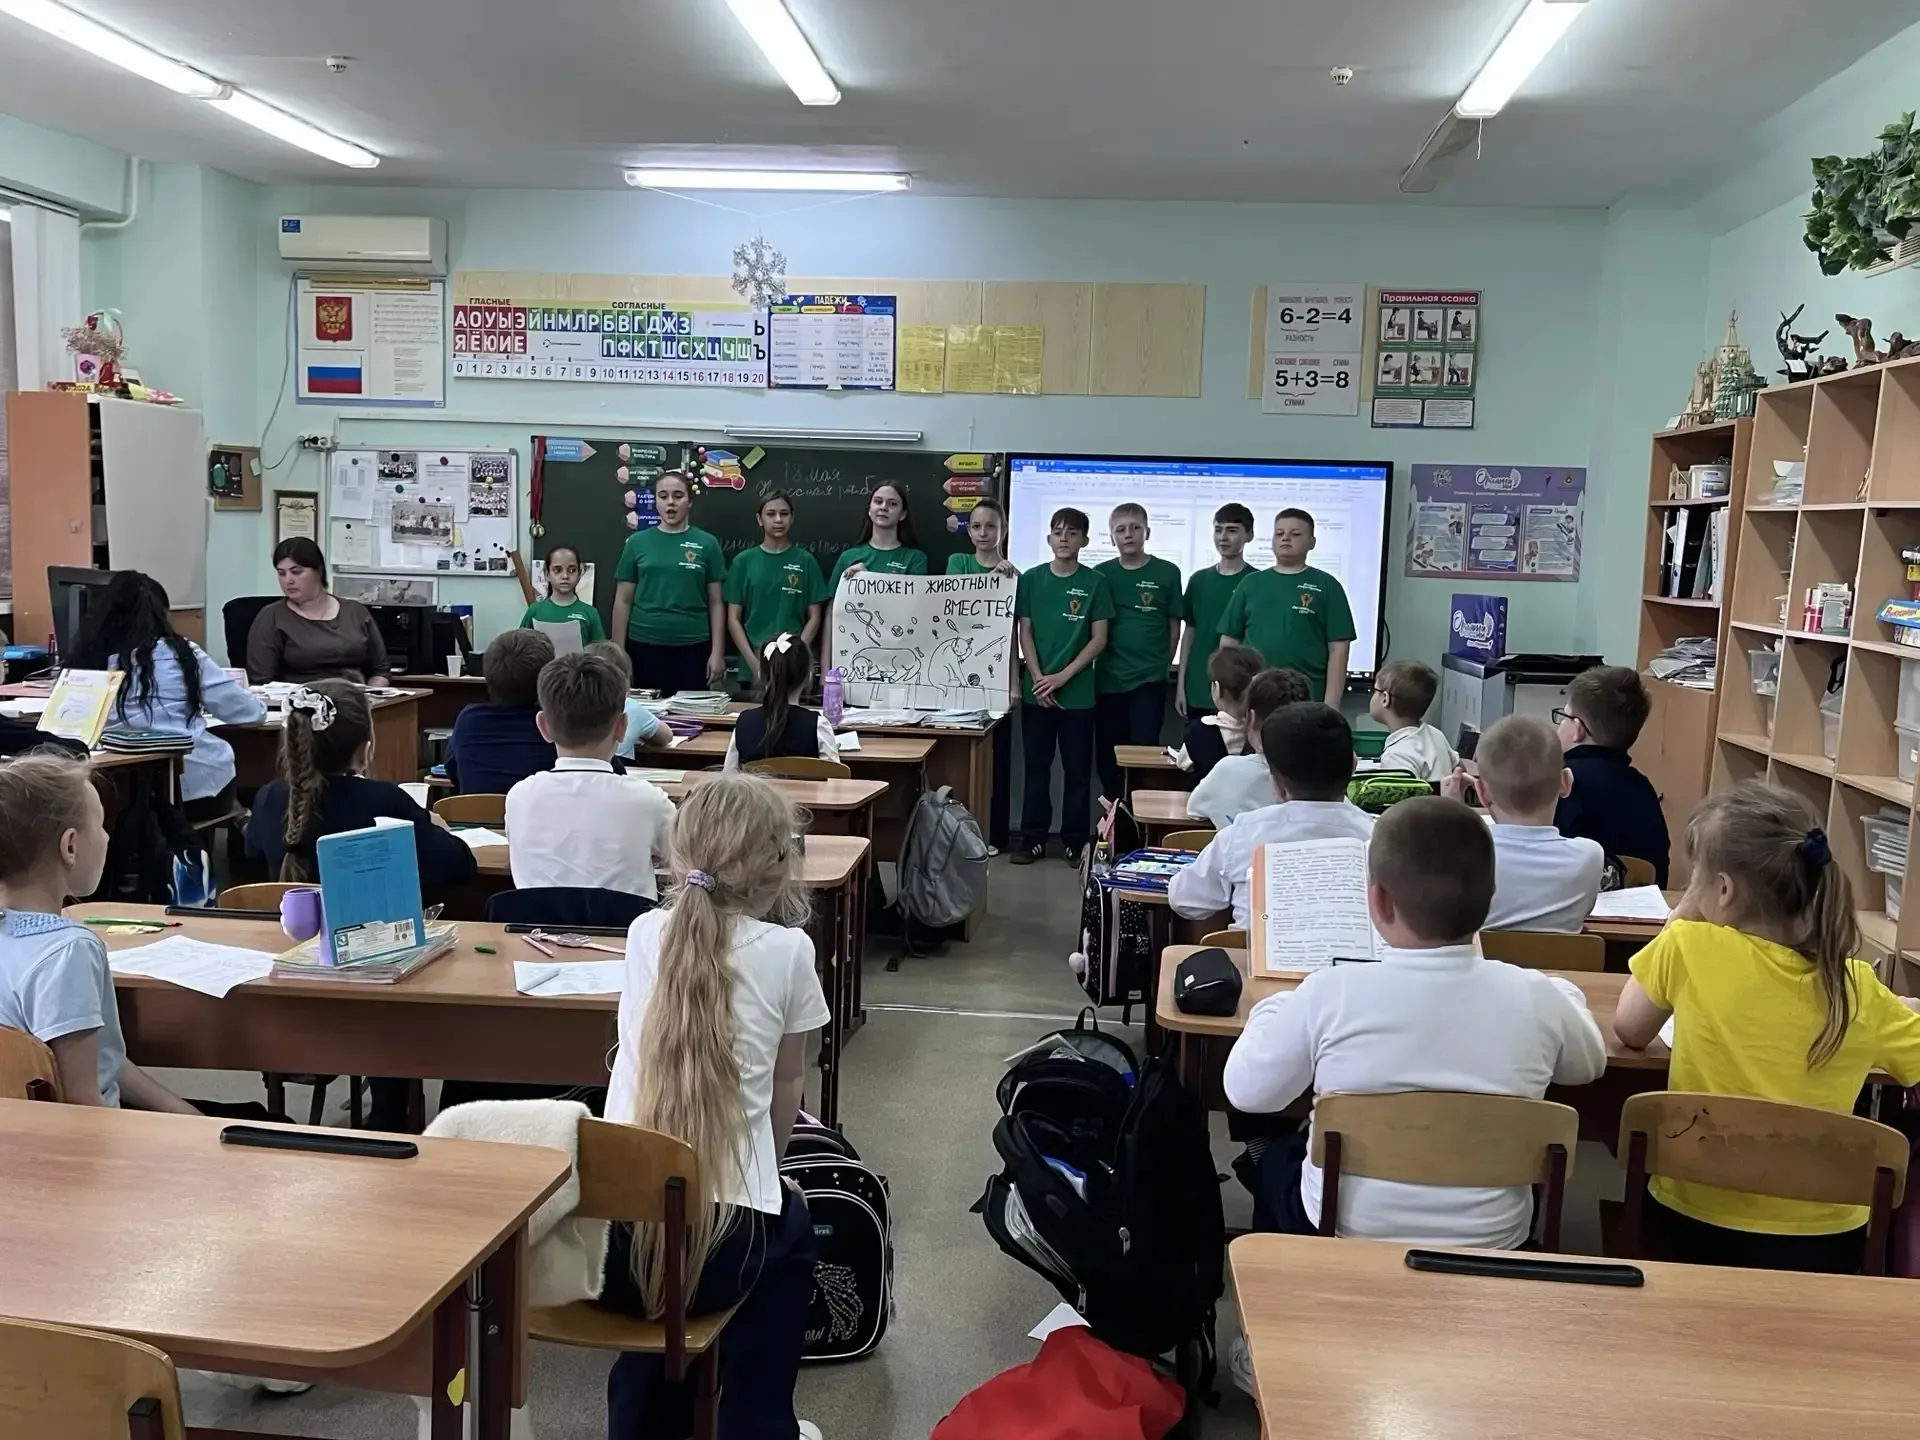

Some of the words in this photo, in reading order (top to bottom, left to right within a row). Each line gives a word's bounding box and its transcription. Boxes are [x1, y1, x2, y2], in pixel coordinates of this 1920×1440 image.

[469, 298, 511, 306] ГЛАСНЫЕ
[814, 295, 848, 305] ПАДЕЖИ
[1383, 293, 1439, 303] Правильная
[612, 301, 666, 310] СОГЛАСНЫЕ
[1280, 307, 1352, 324] 6-2=4
[456, 364, 462, 373] 0
[472, 364, 477, 373] 1
[486, 364, 492, 374] 2
[500, 365, 507, 374] 3
[516, 366, 522, 375] 4
[530, 366, 536, 375] 5
[546, 366, 552, 376] 6
[560, 367, 566, 376] 7
[575, 368, 581, 377] 8
[590, 368, 596, 378] 9
[602, 368, 614, 378] 10
[618, 370, 629, 379] 11
[632, 370, 644, 380] 12
[648, 370, 659, 380] 13
[663, 370, 674, 380] 14
[678, 371, 689, 381] 15
[693, 372, 704, 382] 16
[708, 372, 720, 382] 17
[722, 372, 734, 382] 18
[738, 373, 749, 383] 19
[752, 373, 764, 384] 20
[1275, 370, 1349, 389] 5+3=8
[848, 578, 914, 595] ПОМОЖЕМ
[925, 576, 1000, 594] ЖИВОТНЫМ
